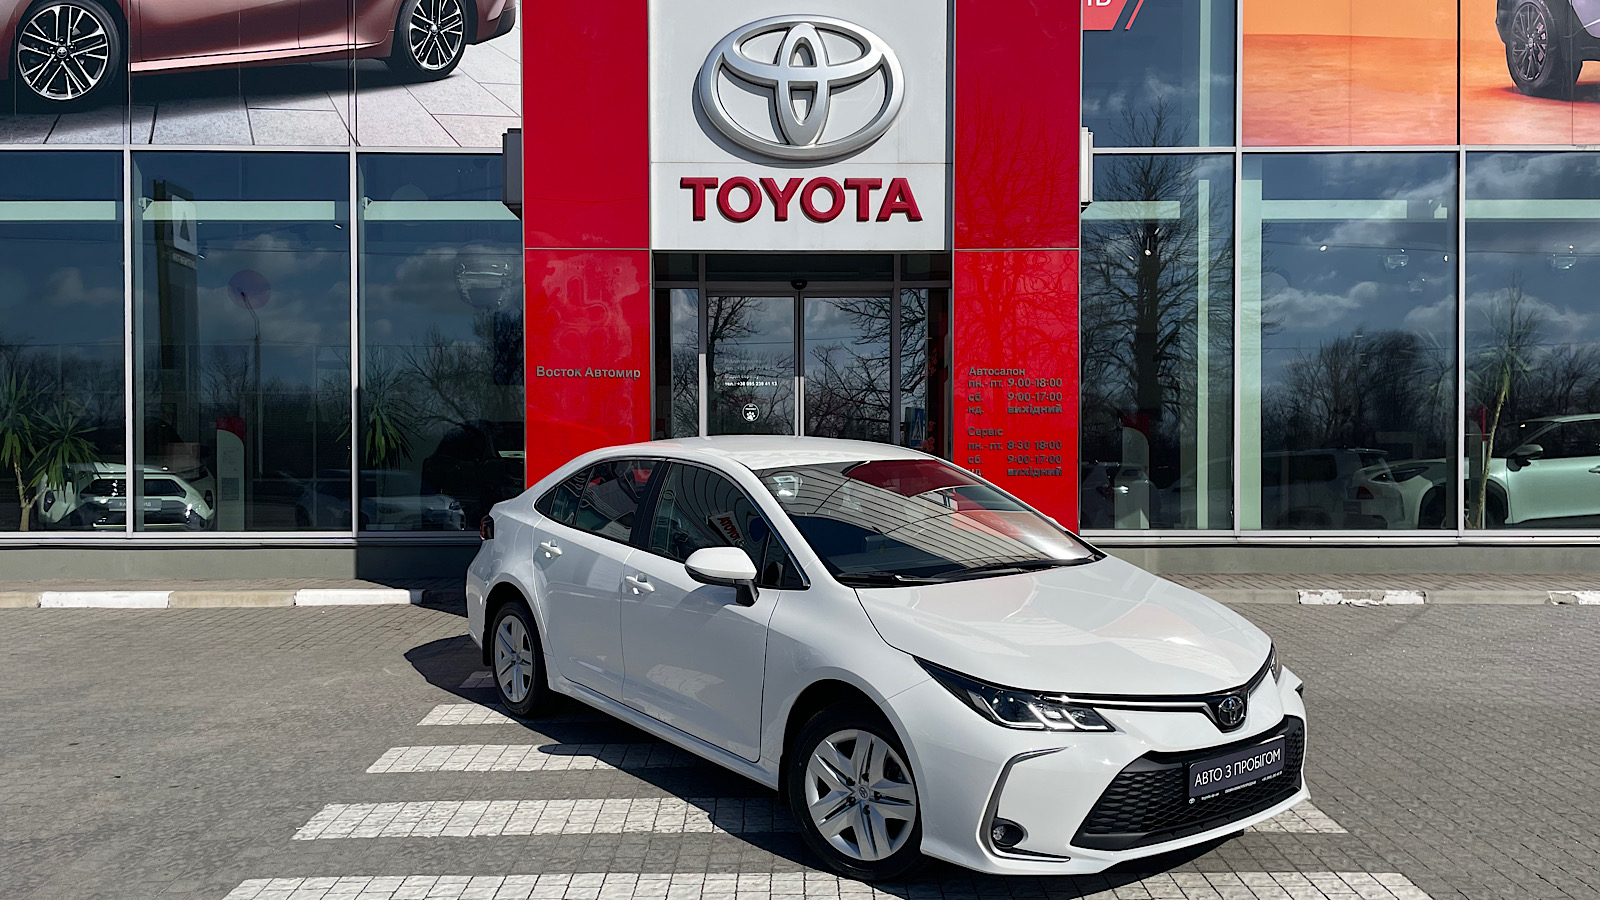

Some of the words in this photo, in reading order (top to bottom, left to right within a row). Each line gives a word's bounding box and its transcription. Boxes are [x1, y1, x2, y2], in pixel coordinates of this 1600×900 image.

[680, 176, 923, 223] TOYOTA
[536, 366, 582, 377] Восток
[584, 367, 641, 381] Автомир
[968, 367, 1026, 376] Автосалон
[968, 392, 983, 402] сб.
[1007, 404, 1062, 415] вихідний
[967, 427, 1004, 438] Сервіс
[967, 455, 984, 464] сб.
[1007, 455, 1062, 464] 9:00-17:00
[1007, 466, 1062, 477] вихідний
[1194, 767, 1223, 788] АВТО
[1233, 748, 1281, 776] ПРОБІГОМ
